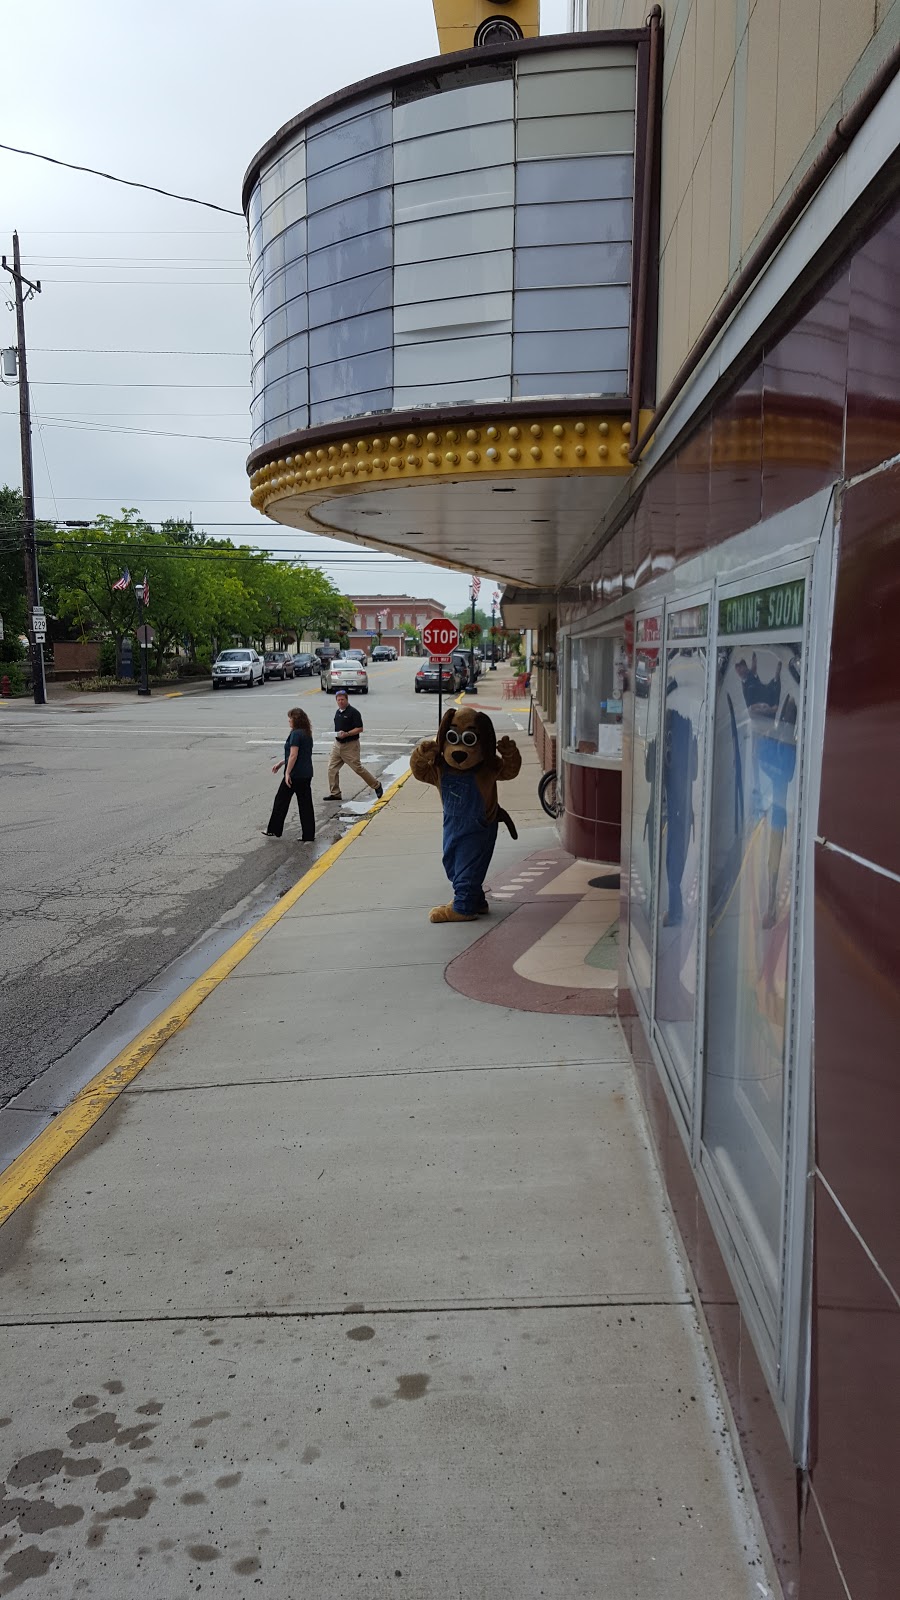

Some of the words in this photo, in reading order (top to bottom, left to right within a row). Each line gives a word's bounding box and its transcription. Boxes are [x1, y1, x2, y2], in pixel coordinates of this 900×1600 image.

[728, 596, 762, 632] COMING
[768, 586, 802, 626] SOON
[34, 621, 45, 630] 229
[424, 629, 458, 644] STOP
